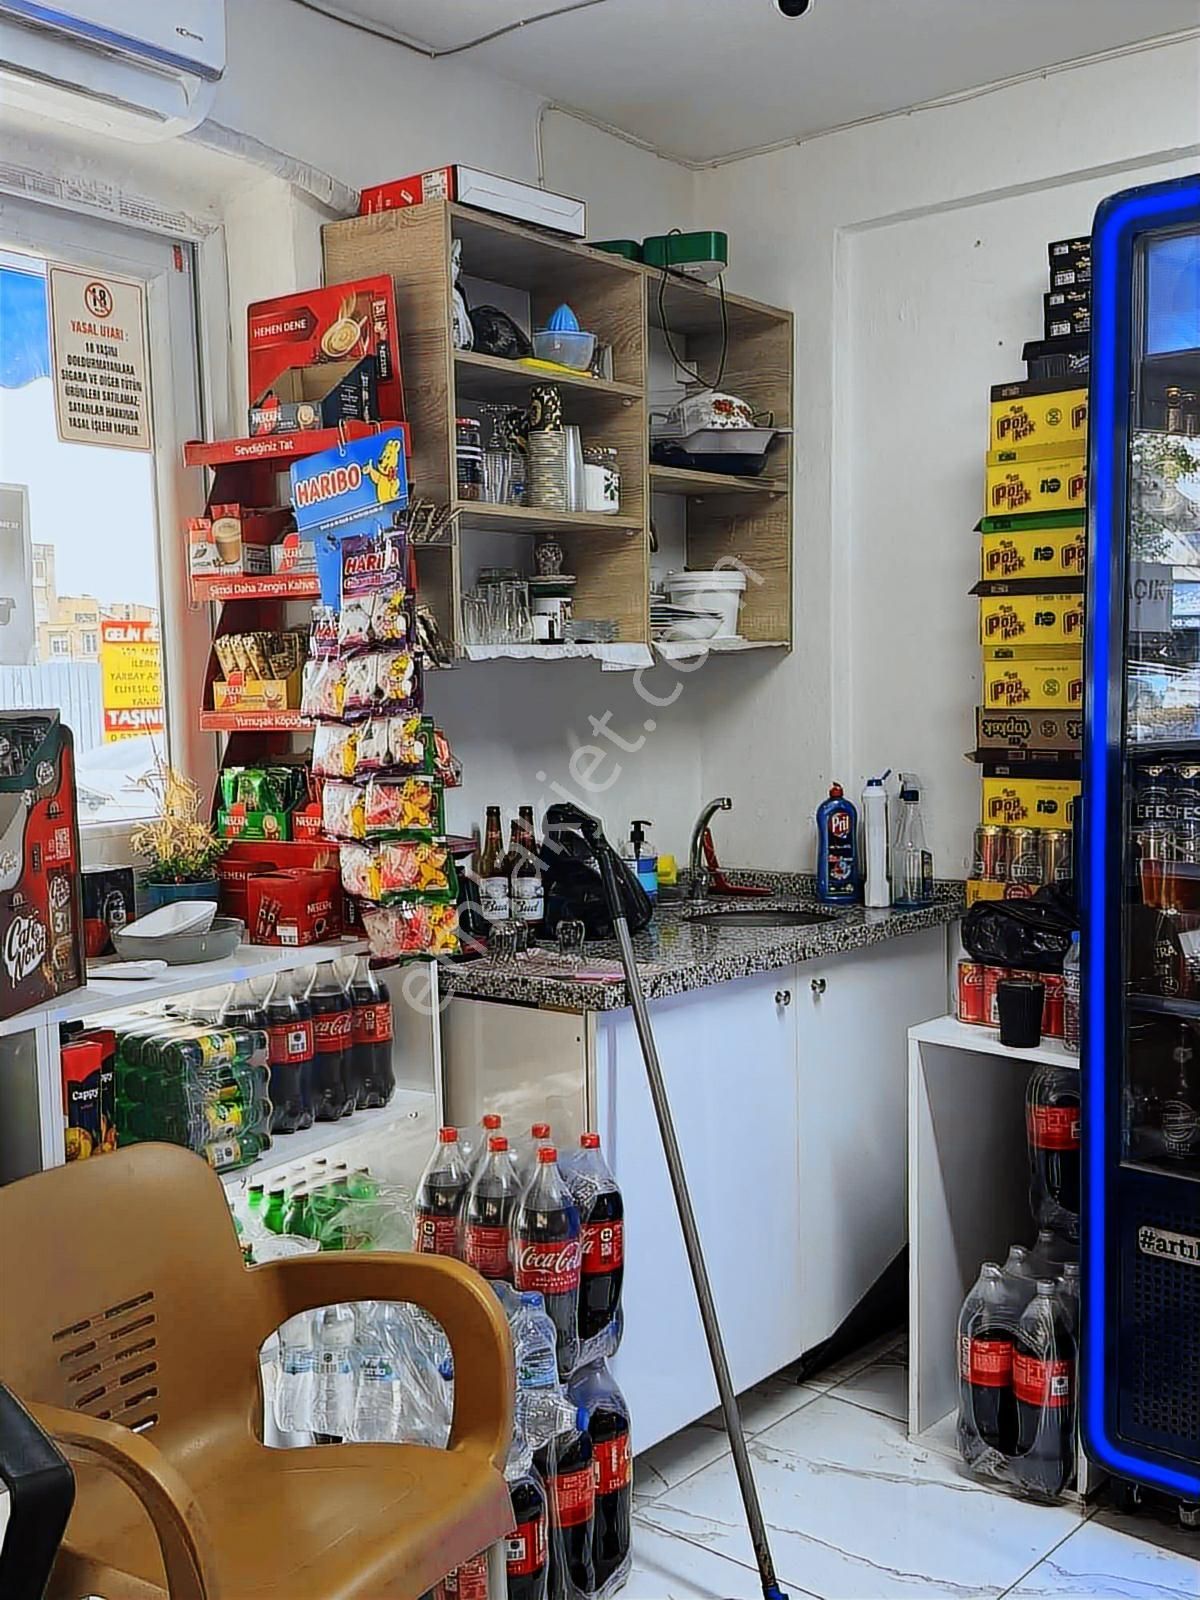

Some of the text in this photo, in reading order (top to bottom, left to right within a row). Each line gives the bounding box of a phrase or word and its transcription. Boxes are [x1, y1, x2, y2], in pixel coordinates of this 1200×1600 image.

[70, 320, 99, 336] YASAL
[283, 318, 308, 332] DENE
[89, 374, 98, 386] VE
[997, 412, 1030, 440] Pop
[235, 440, 293, 455] Sevdiğiniz Tat
[295, 463, 361, 508] HARIBO
[992, 480, 1024, 507] Pop
[345, 547, 399, 575] HARIO
[987, 547, 1018, 572] Pop
[234, 582, 257, 593] Daha
[258, 582, 287, 594] Zengin
[288, 578, 315, 591] Kahve
[985, 612, 1018, 637] Pop
[990, 679, 1023, 702] Pop
[988, 797, 1020, 823] Pop
[831, 813, 850, 832] Pril
[72, 1088, 98, 1101] Cappy
